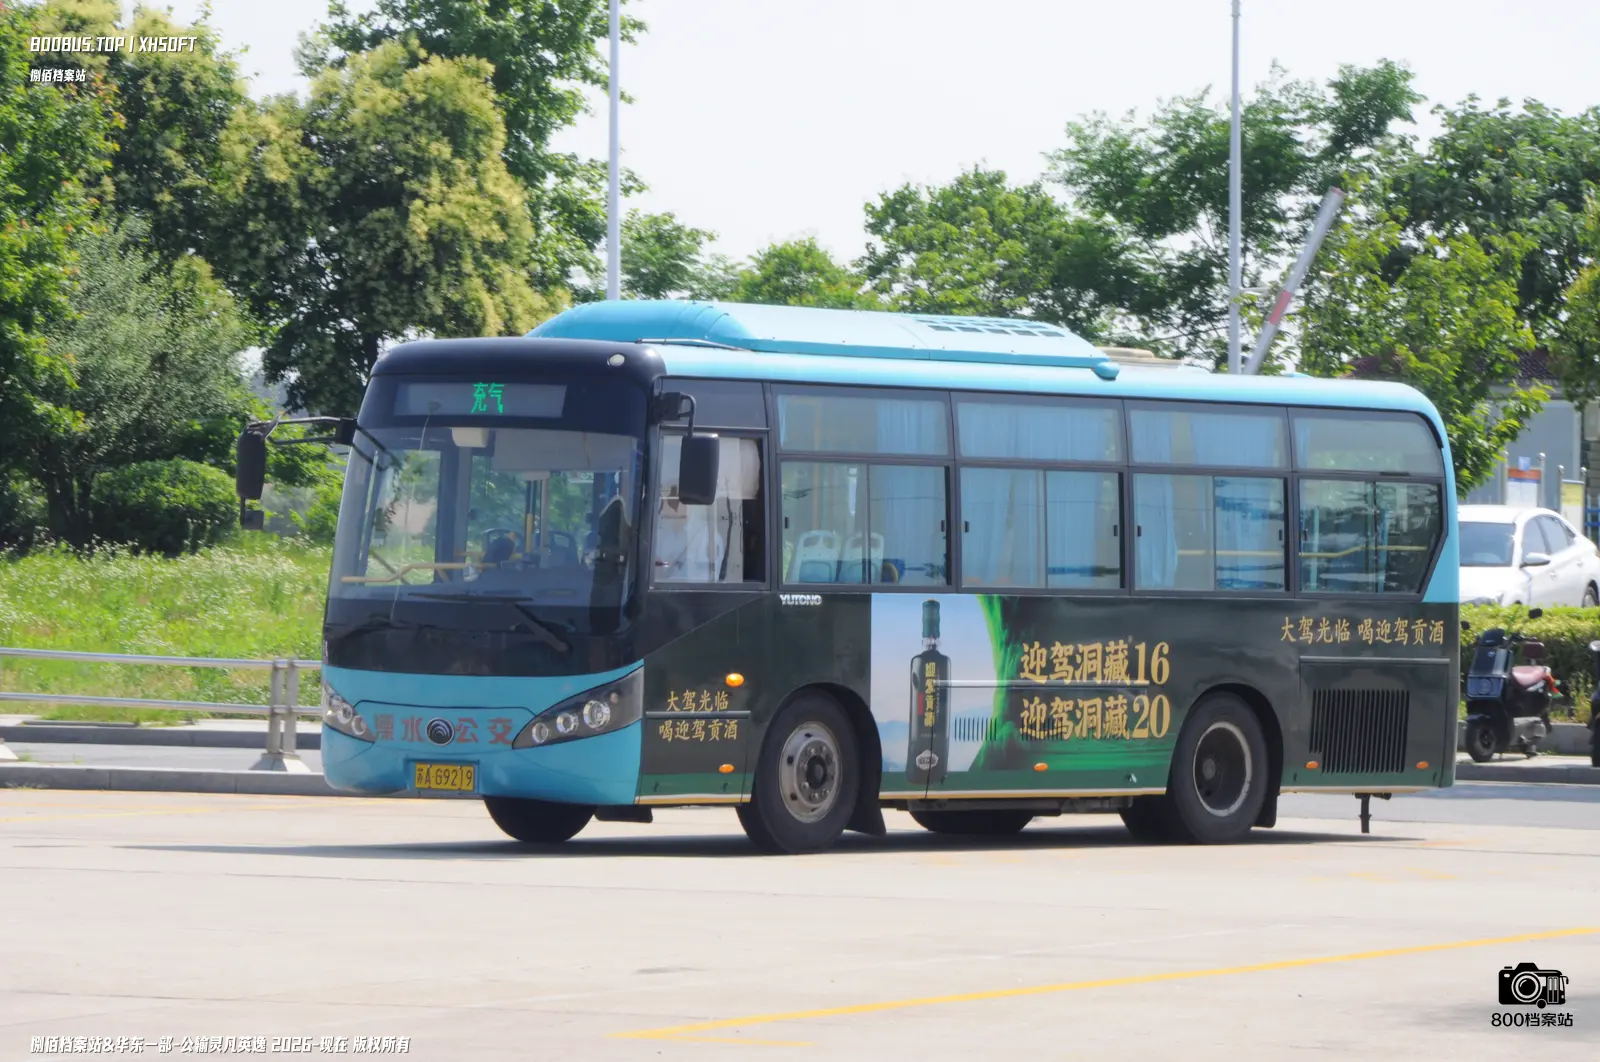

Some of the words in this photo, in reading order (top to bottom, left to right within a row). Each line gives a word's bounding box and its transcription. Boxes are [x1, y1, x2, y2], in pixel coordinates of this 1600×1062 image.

[471, 382, 505, 413] 充气
[1280, 615, 1350, 645] 大驾光临
[1358, 617, 1445, 646] 喝迎驾贡酒
[1020, 639, 1170, 685] 迎驾洞藏16
[666, 689, 729, 712] 大驾光临
[456, 717, 513, 745] 公交
[659, 719, 738, 742] 喝迎驾贡酒
[1020, 694, 1171, 740] 迎驾洞藏20
